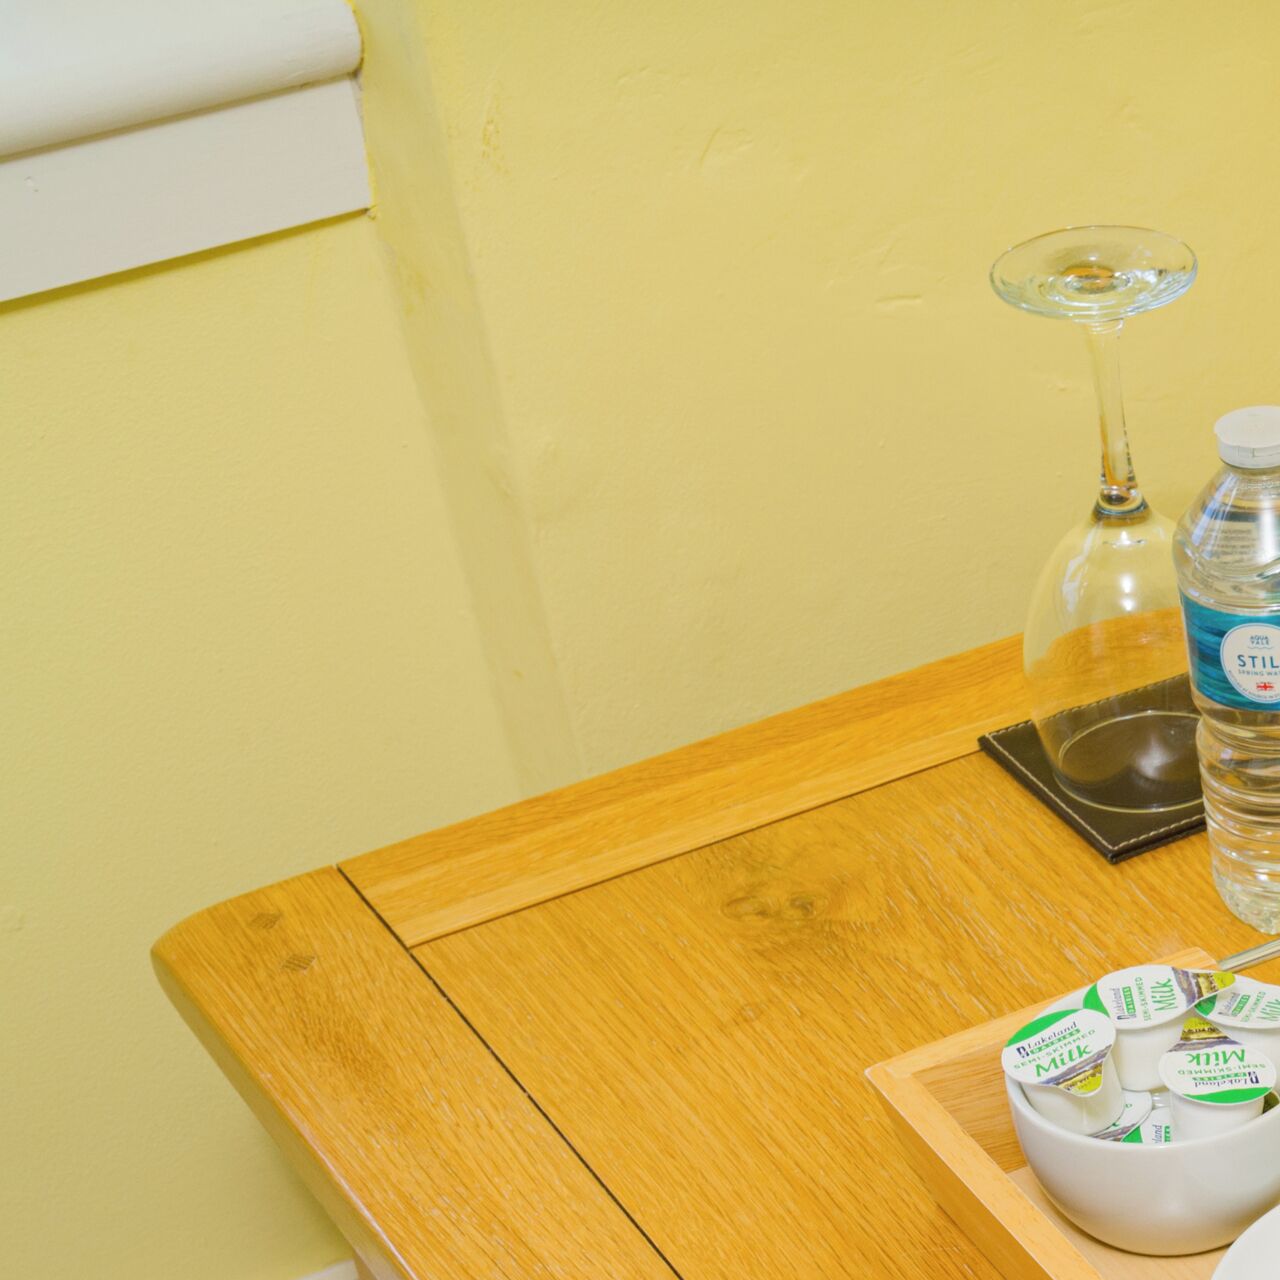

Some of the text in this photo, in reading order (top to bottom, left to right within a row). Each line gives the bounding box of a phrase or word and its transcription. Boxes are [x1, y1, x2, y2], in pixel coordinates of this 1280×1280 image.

[1238, 669, 1264, 677] SPRING
[1150, 977, 1178, 1011] Milk
[1027, 1021, 1077, 1049] Lakeland
[1014, 1029, 1096, 1069] SEMI-SKIMMED
[1185, 1049, 1245, 1066] Milk
[1035, 1044, 1092, 1077] Milk
[1177, 1063, 1266, 1075] SEMI-SKIMMED
[1195, 1078, 1248, 1088] Lakeland
